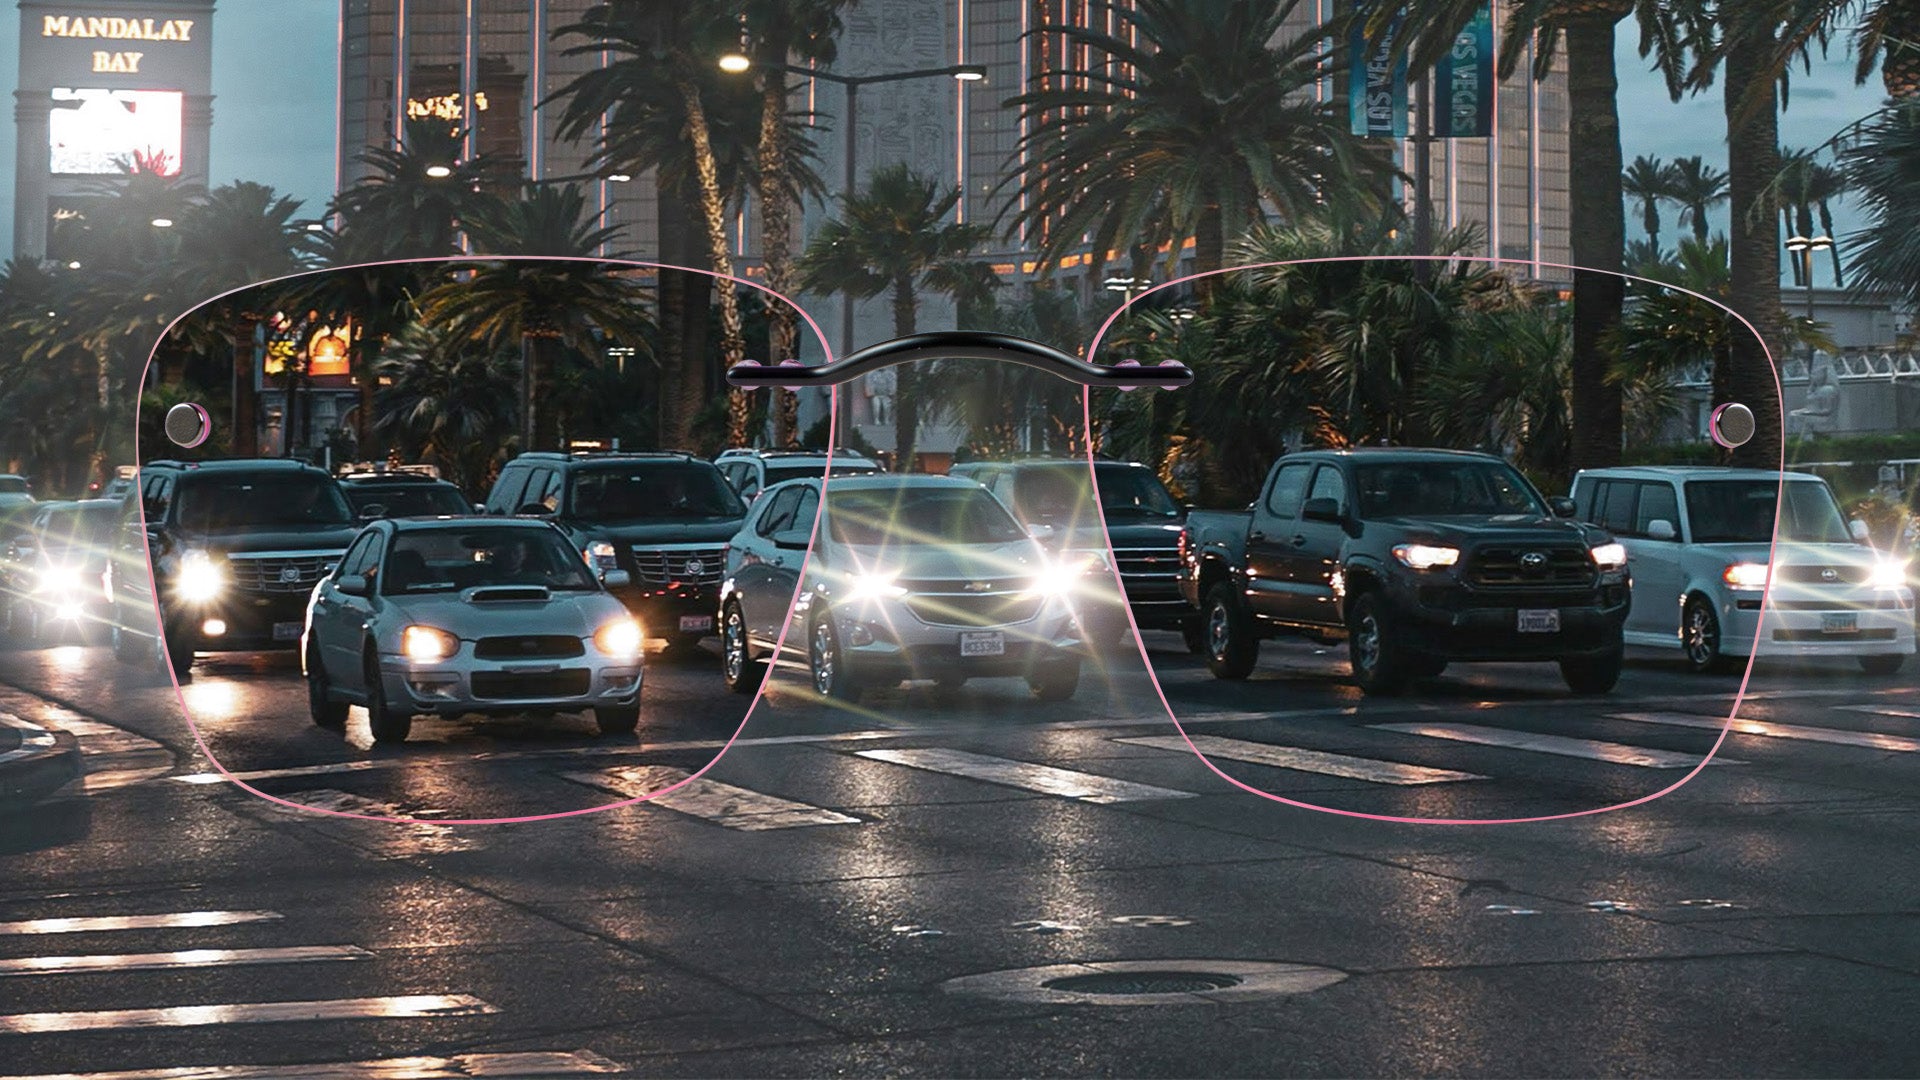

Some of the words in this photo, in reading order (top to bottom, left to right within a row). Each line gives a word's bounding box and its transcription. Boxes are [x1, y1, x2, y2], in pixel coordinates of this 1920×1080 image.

[42, 15, 194, 41] MANDALAY
[1452, 22, 1477, 59] AS
[92, 51, 143, 73] BAY
[1367, 92, 1393, 131] LAS
[1452, 64, 1478, 131] VEGAS
